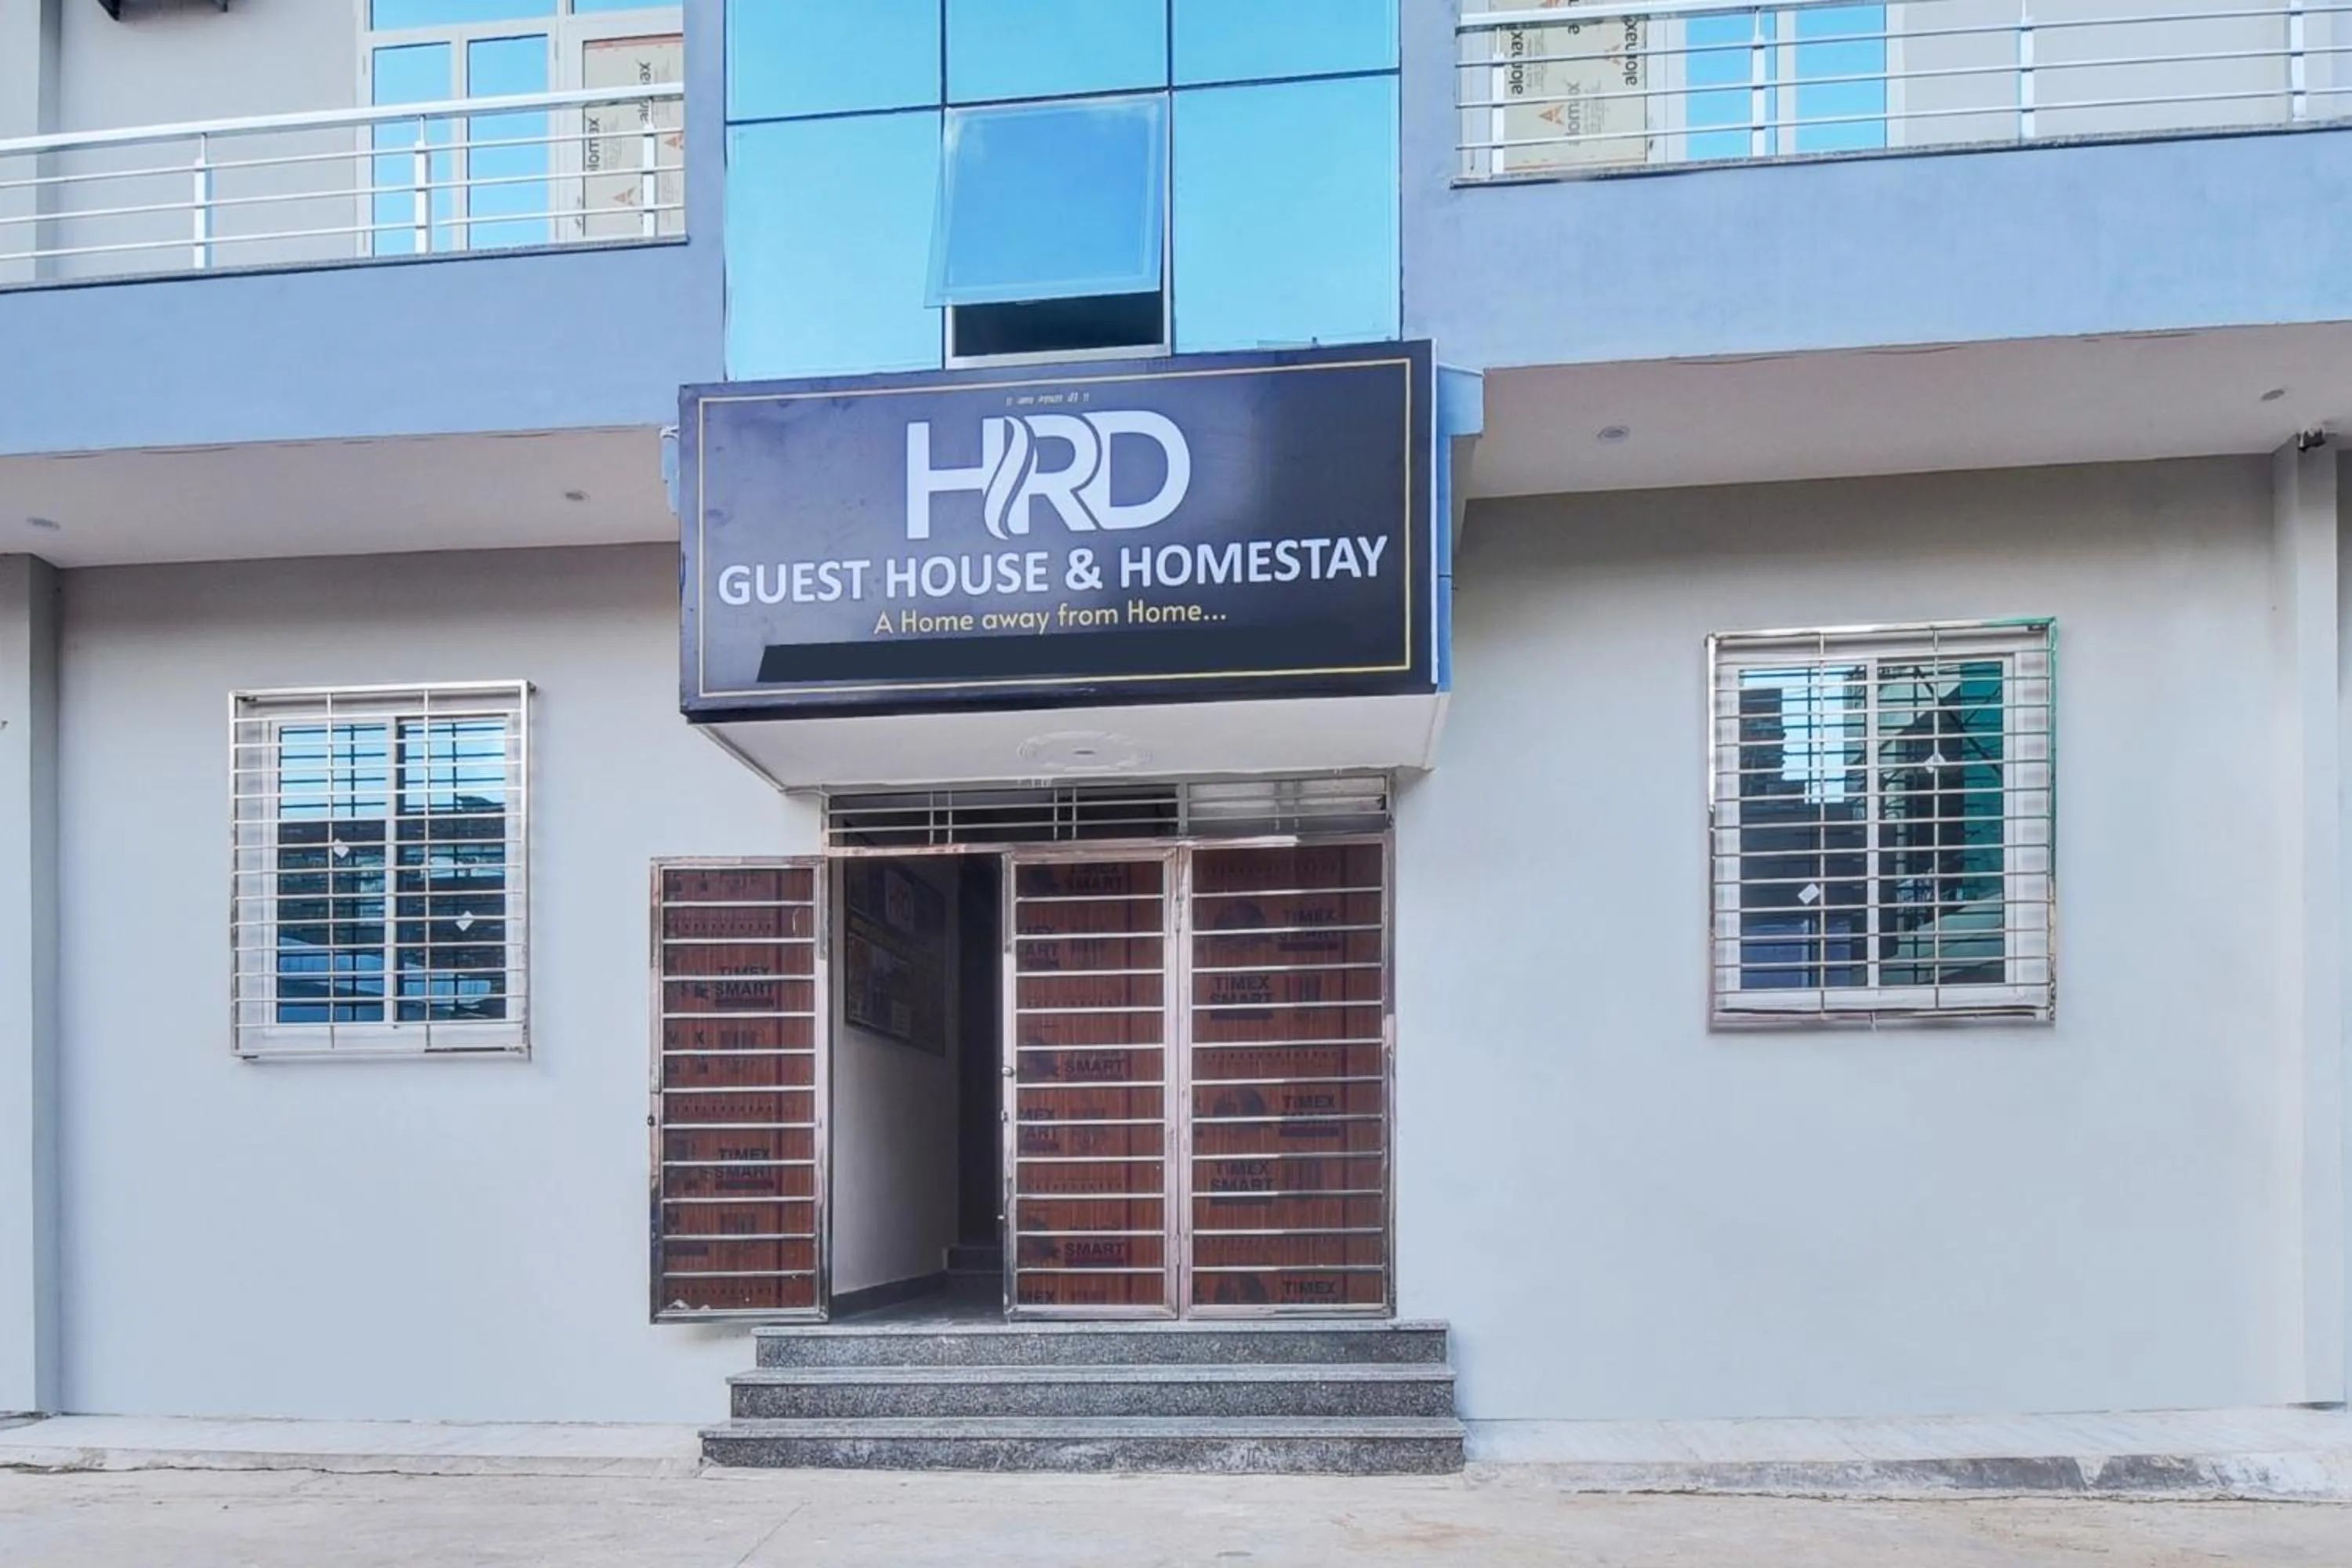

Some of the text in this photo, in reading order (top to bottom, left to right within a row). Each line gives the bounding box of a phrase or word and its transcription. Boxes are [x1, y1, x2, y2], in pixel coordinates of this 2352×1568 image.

[906, 410, 1191, 541] HRD
[717, 535, 1388, 606] GUEST HOUSE & HOMESTAY
[873, 599, 1227, 636] A Home away from Home...
[1065, 1242, 1123, 1256] SMART
[1282, 1280, 1334, 1295] TIMEX
